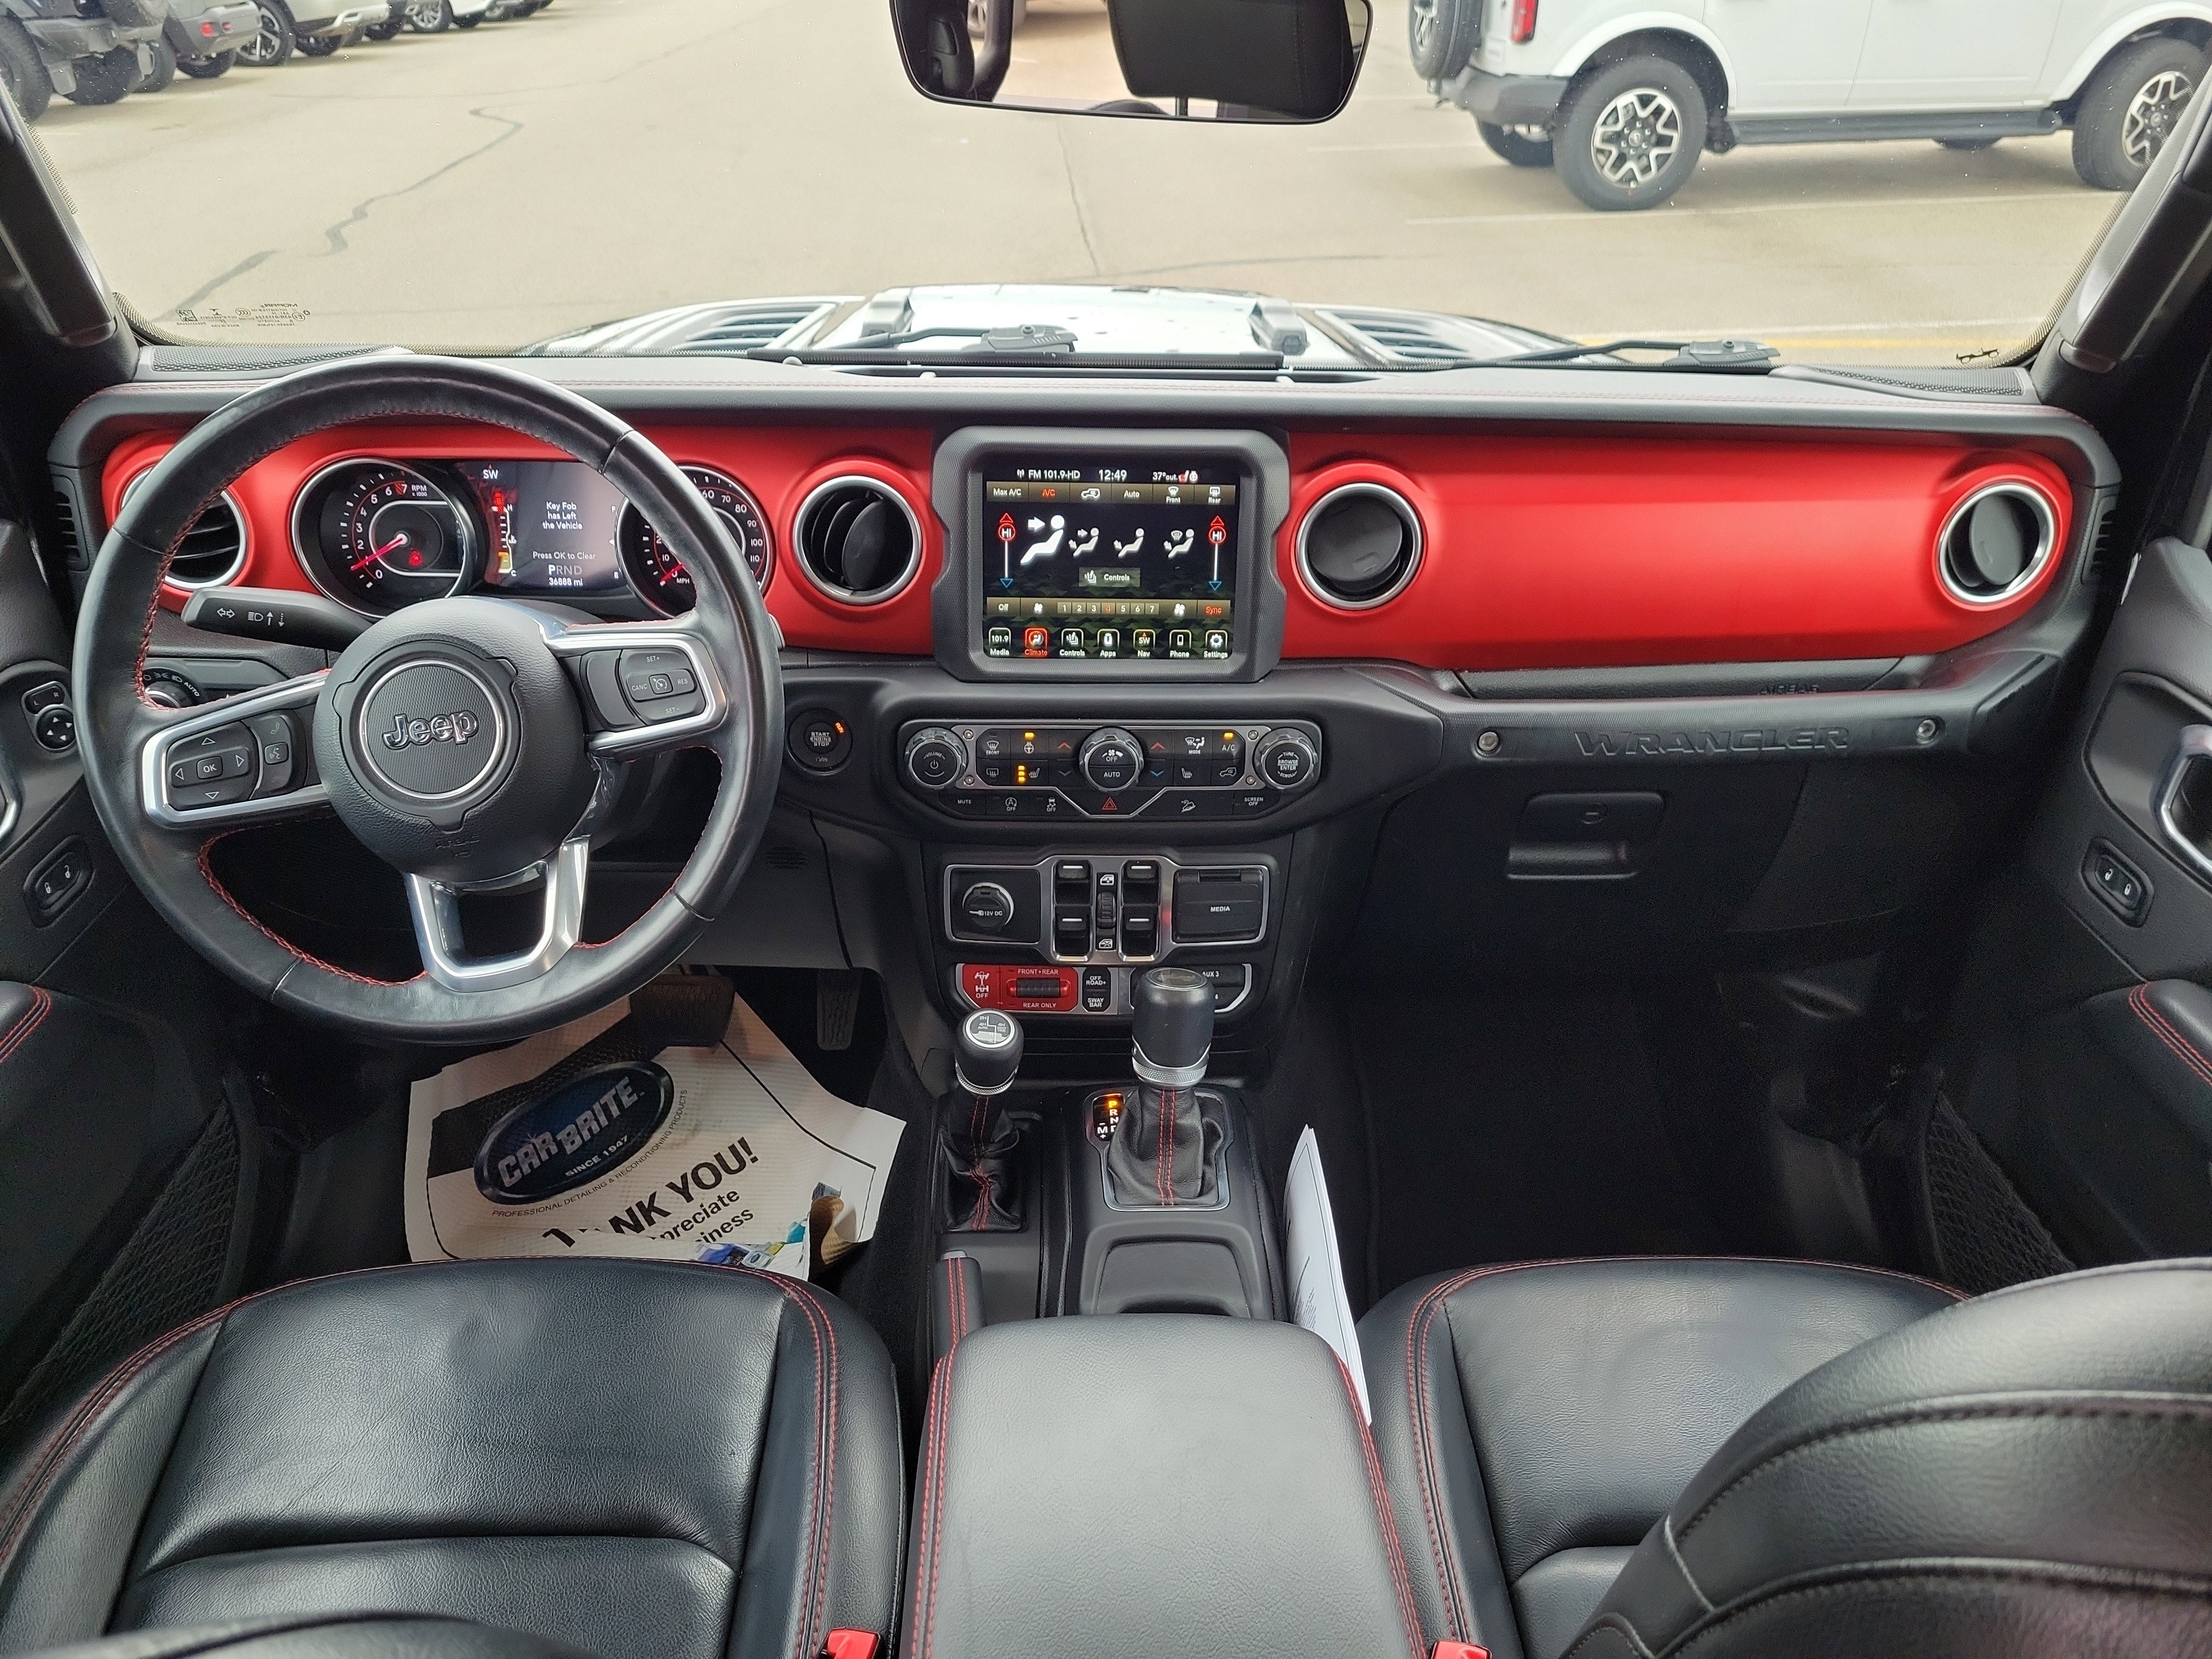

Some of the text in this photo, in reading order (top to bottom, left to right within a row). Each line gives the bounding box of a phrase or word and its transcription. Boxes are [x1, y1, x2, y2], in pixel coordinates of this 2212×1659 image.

[483, 469, 498, 479] SW
[1028, 470, 1041, 479] FM
[1099, 469, 1127, 481] 12:49
[385, 486, 392, 495] 6
[402, 484, 408, 493] 7
[993, 488, 1007, 496] Max
[1042, 488, 1056, 496] A/C
[371, 494, 378, 504] 5
[702, 490, 715, 499] 60
[721, 495, 731, 503] 70
[1124, 490, 1140, 498] Auto
[360, 506, 367, 516] 4
[546, 501, 577, 511] Key Fob
[735, 504, 747, 513] 80
[547, 511, 577, 520] has Left
[356, 523, 363, 533] 3
[542, 520, 583, 530] the Vehicle
[1002, 528, 1012, 538] HI
[1212, 531, 1222, 541] HI
[357, 540, 364, 549] 2
[751, 538, 763, 546] 100
[533, 551, 552, 560] Press
[554, 551, 566, 560] OK
[577, 551, 596, 560] Clear
[375, 569, 382, 579] 0
[549, 578, 583, 586] 36888 mi
[1205, 606, 1222, 615] Sync
[1138, 636, 1150, 645] SW
[1099, 650, 1116, 658] Apps
[184, 682, 200, 697] AUTO
[383, 712, 478, 747] Jeep
[1575, 727, 1849, 757] WRANGLER
[203, 764, 217, 773] OK
[498, 1076, 639, 1187] CAR BRITE
[492, 1202, 562, 1217] PROFESSIONAL
[563, 1182, 607, 1205] DETAILING
[615, 1130, 672, 1180] RECONDITIONING
[670, 1089, 688, 1130] PRODUCTS
[565, 1135, 628, 1177] SINCE 1947
[542, 1137, 759, 1248] TNK YOU!
[647, 1189, 740, 1241] preciate
[695, 1208, 754, 1244] iness
